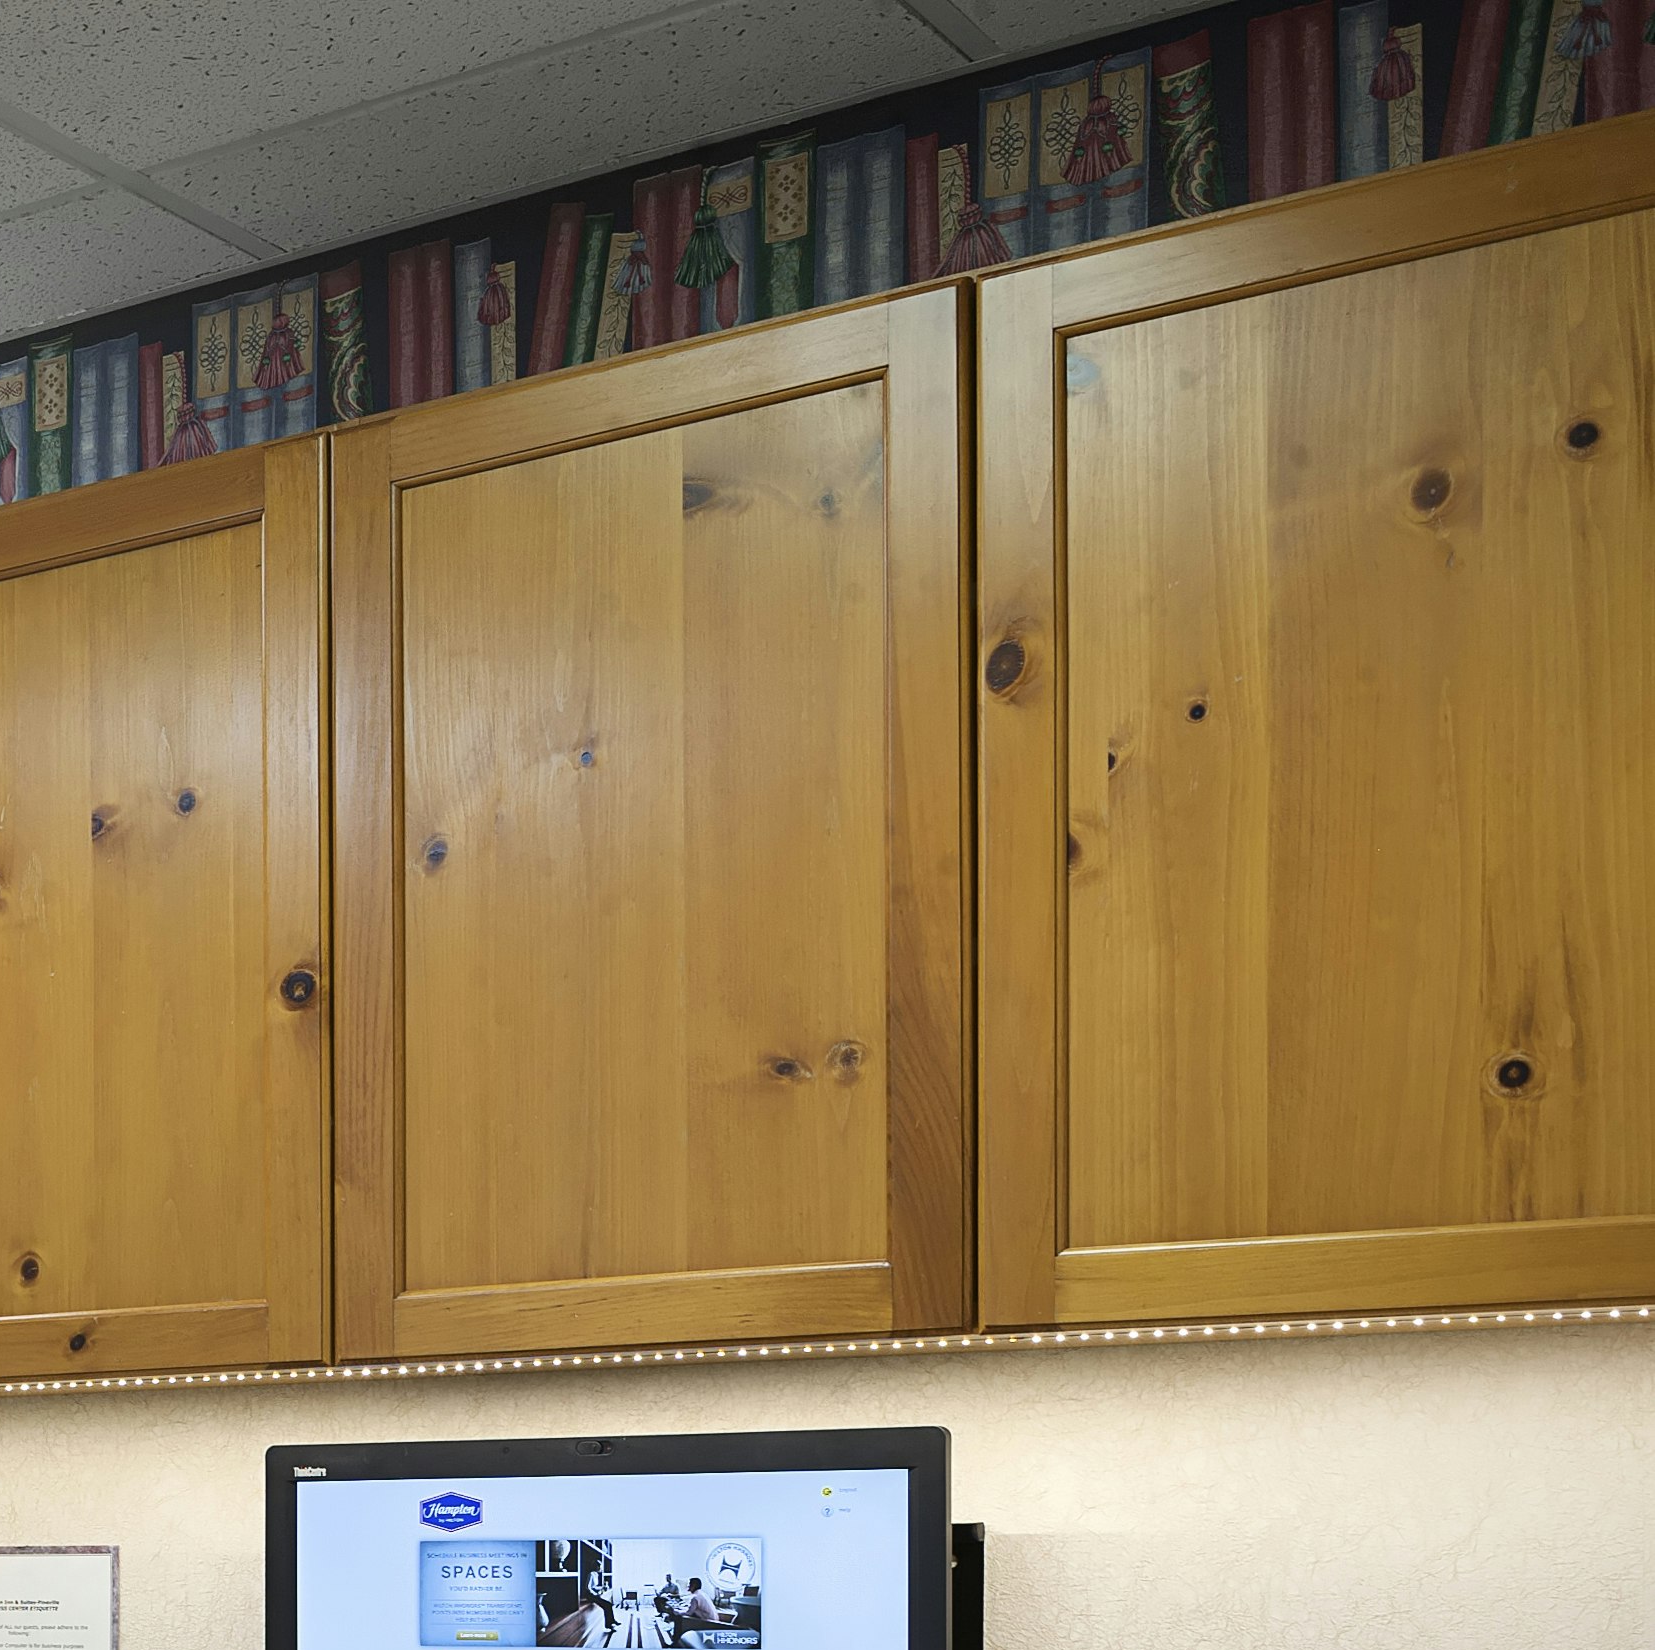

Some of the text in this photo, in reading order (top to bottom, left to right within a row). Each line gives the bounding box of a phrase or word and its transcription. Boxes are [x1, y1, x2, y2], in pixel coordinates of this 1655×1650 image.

[423, 1503, 480, 1519] Hampton
[441, 1565, 513, 1579] SPACES
[717, 1637, 758, 1645] HHONORS
